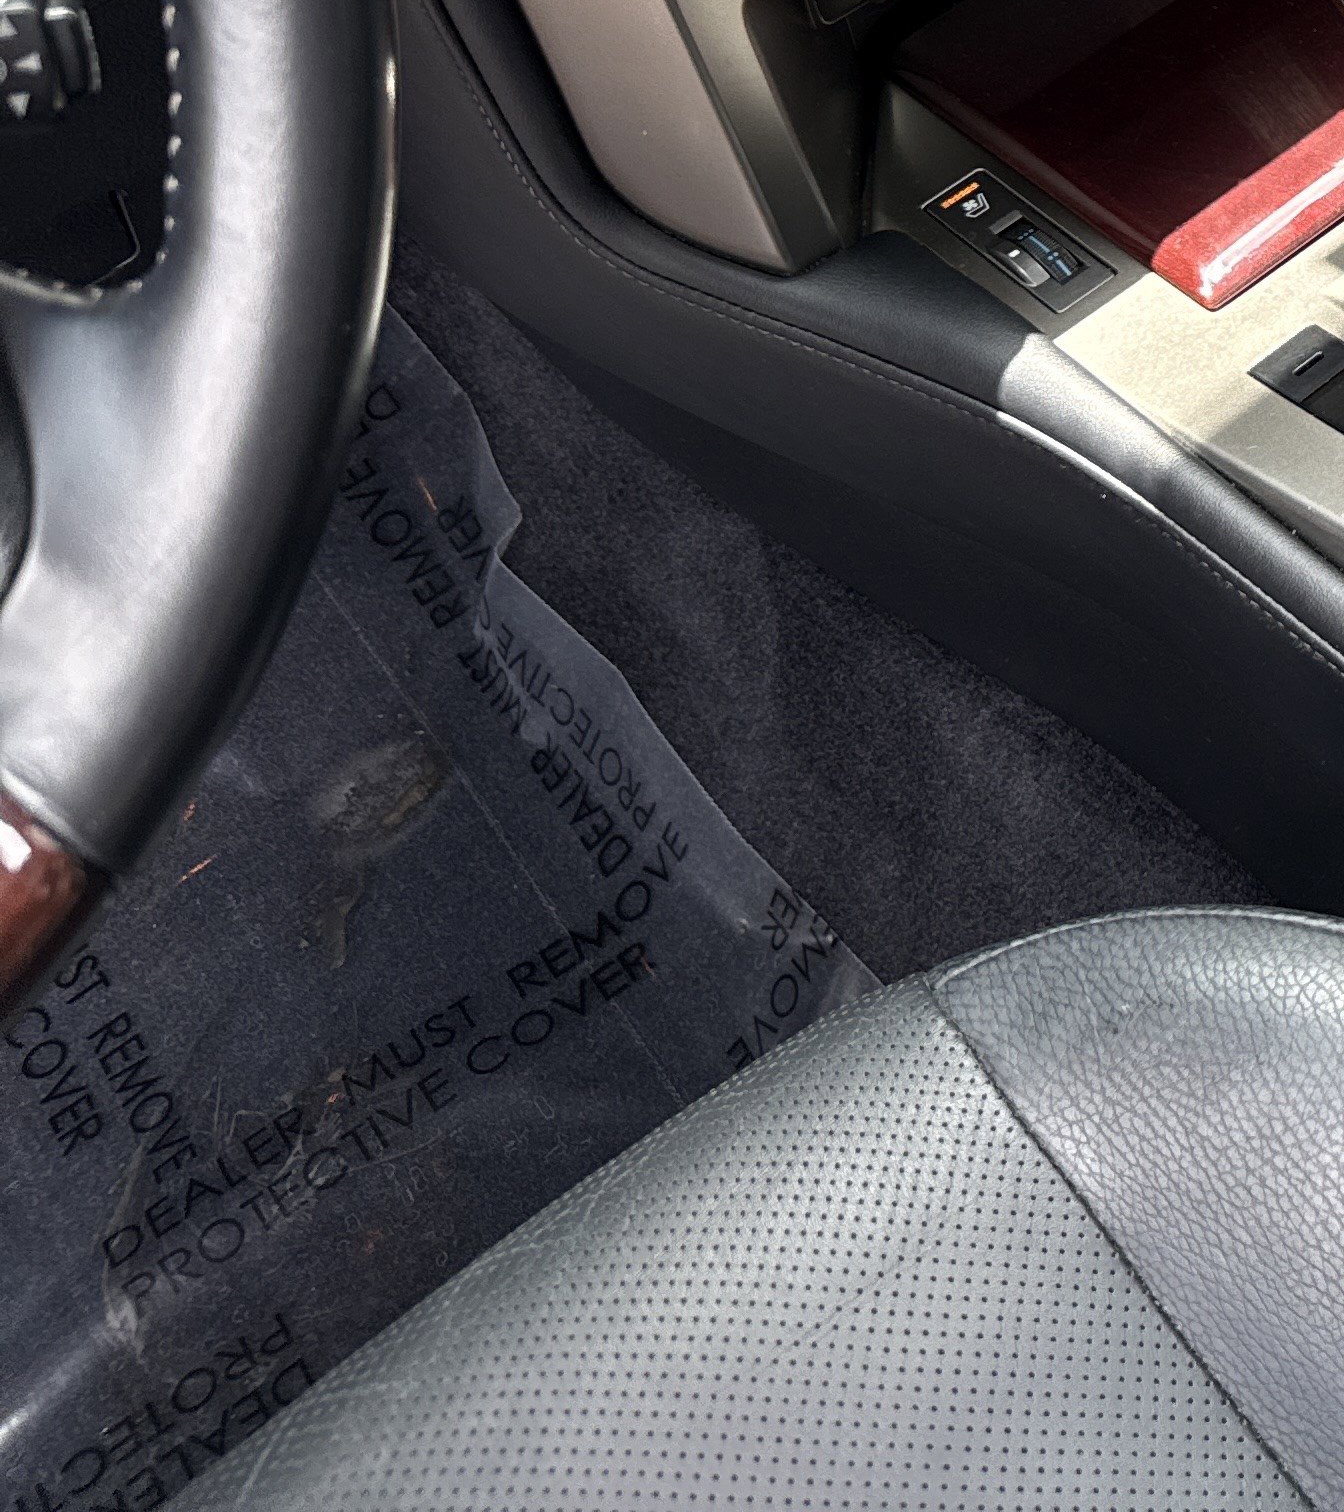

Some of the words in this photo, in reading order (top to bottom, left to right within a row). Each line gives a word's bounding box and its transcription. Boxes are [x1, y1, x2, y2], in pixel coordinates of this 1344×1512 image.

[457, 633, 527, 738] MUST
[494, 620, 658, 834] PROTECTIVE
[529, 736, 633, 878] DEALER
[86, 1011, 198, 1185] REMOVE
[101, 1103, 314, 1270] DEALER
[341, 994, 478, 1111] MUST
[506, 817, 690, 998] REMOVE
[120, 1070, 460, 1322] PROTECTIVE
[465, 940, 653, 1078] COVER
